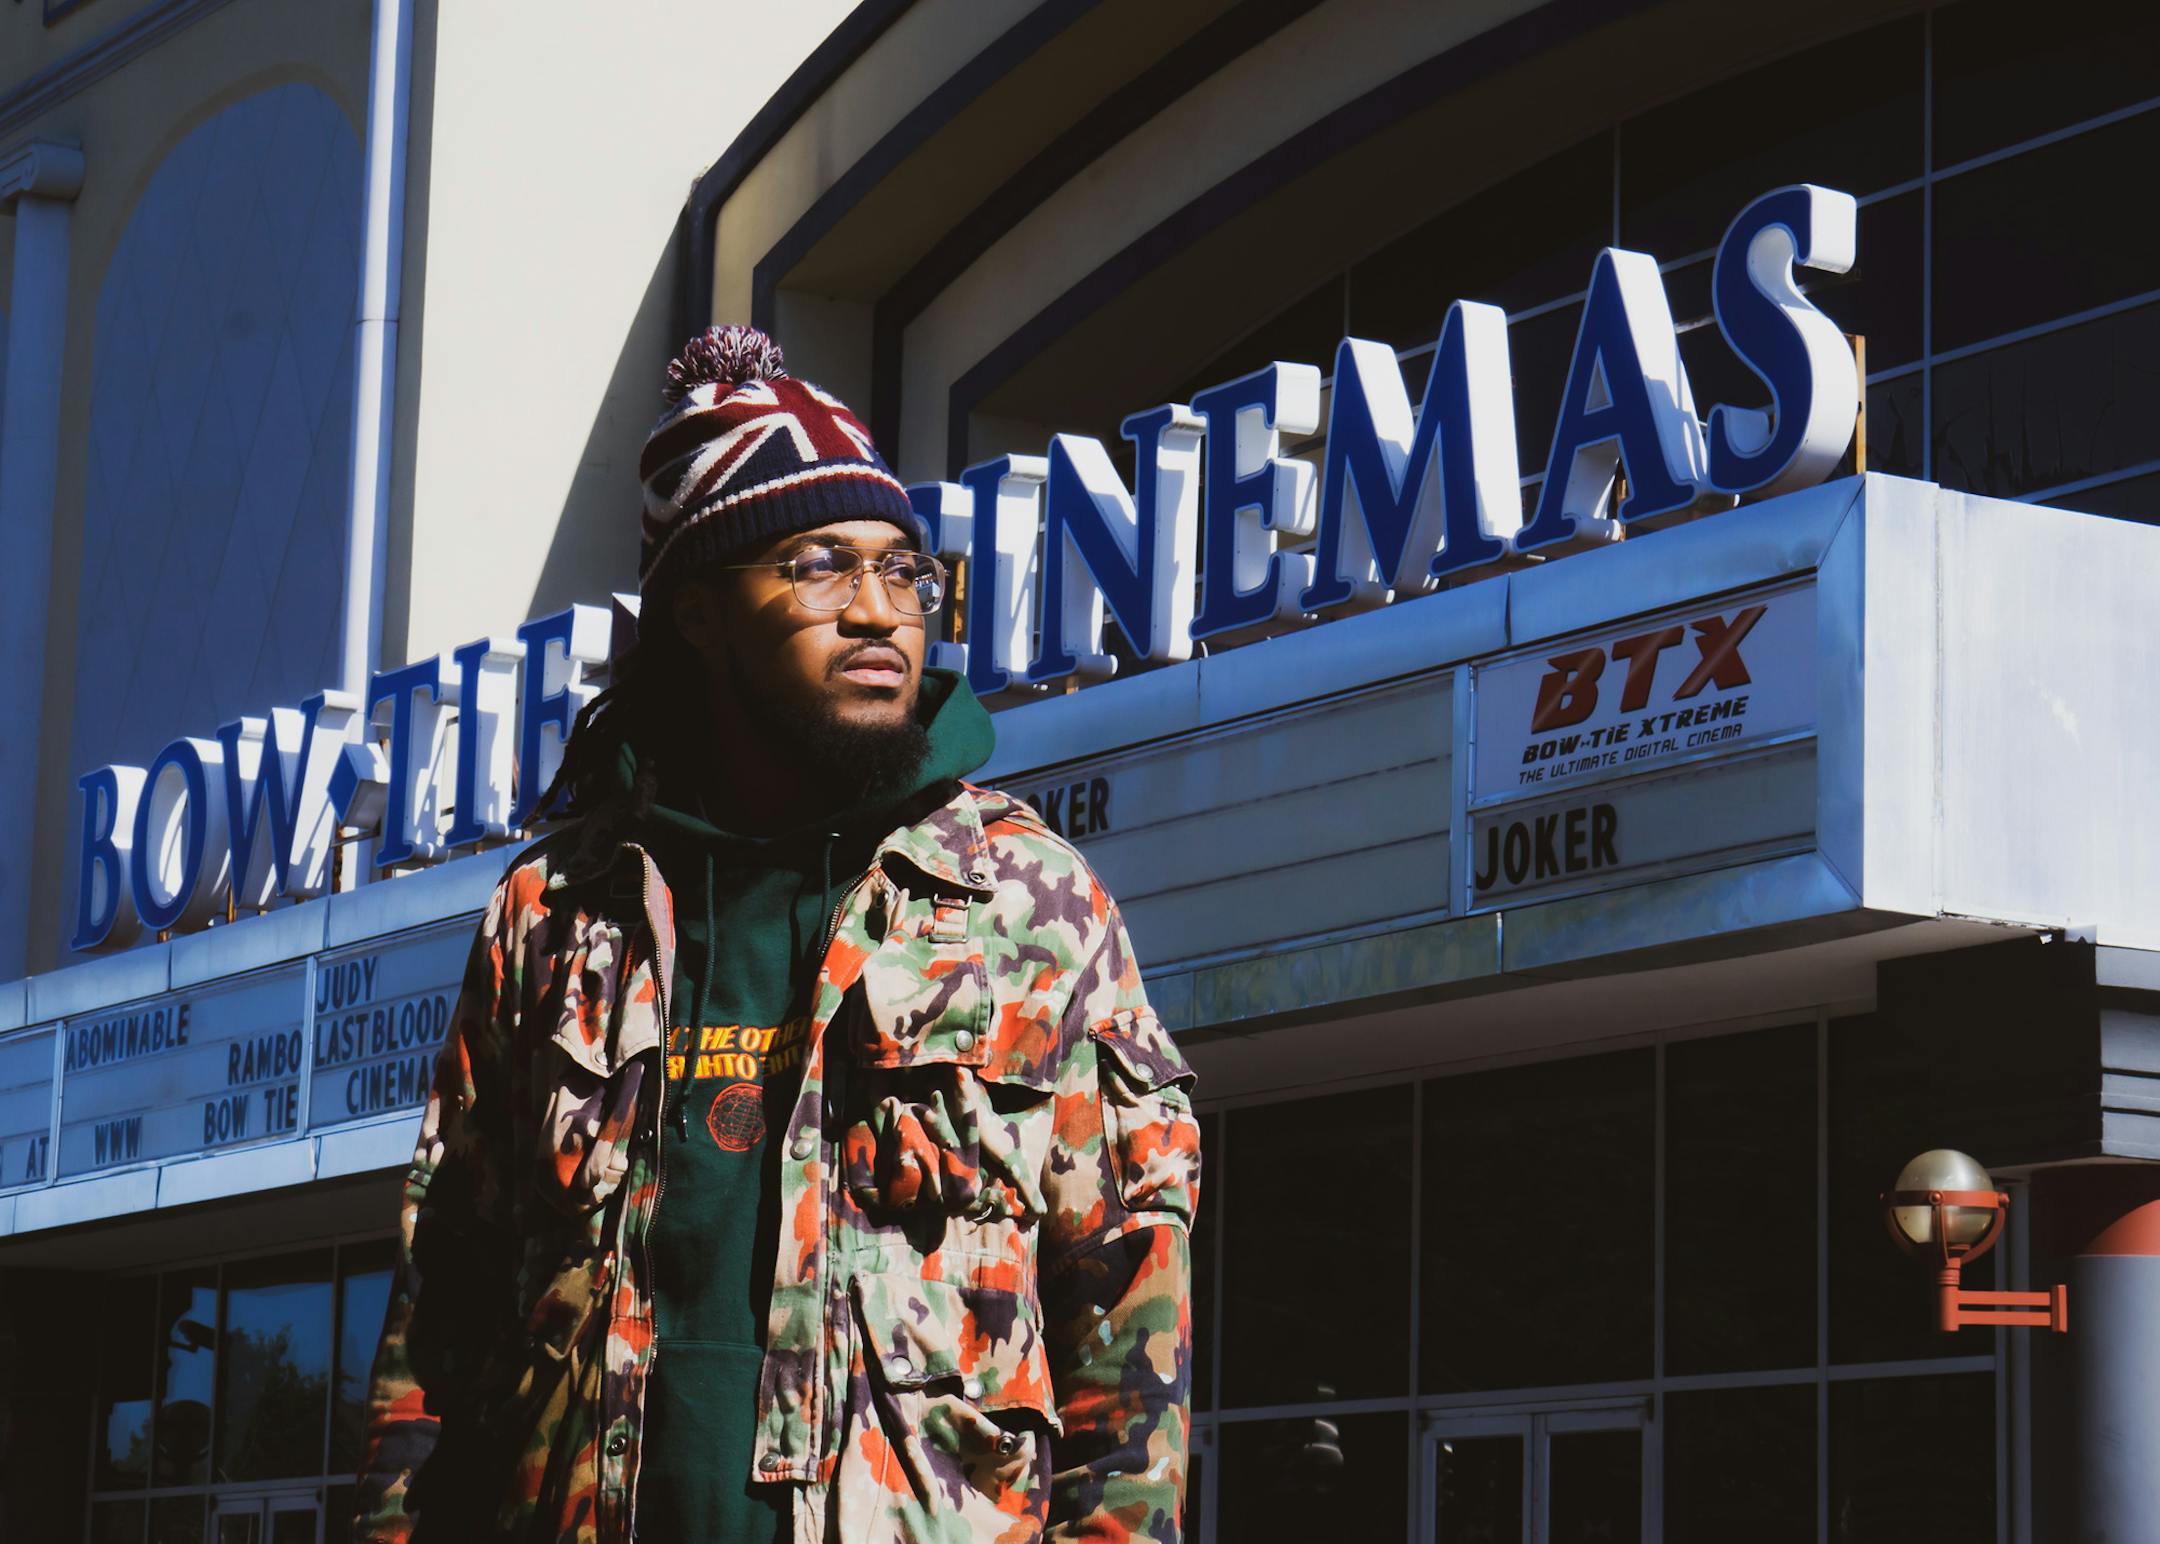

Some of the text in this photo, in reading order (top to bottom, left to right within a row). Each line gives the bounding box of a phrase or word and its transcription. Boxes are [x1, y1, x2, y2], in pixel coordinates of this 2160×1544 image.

[72, 184, 1856, 950] BOW TIE INEMAS
[1531, 603, 1768, 734] BTX
[1638, 696, 1749, 737] XTREME
[1519, 723, 1743, 784] THE ULTIMATE DIGITAL CINEMA
[1025, 776, 1110, 839] KER
[1475, 803, 1618, 890] JOKER
[317, 956, 378, 1013] JUDY
[64, 1003, 190, 1072] ABOMINABLE
[228, 1030, 302, 1085] RAMBO
[26, 1136, 50, 1179] AT
[204, 1095, 248, 1145] BOW
[265, 1085, 298, 1133] TIE
